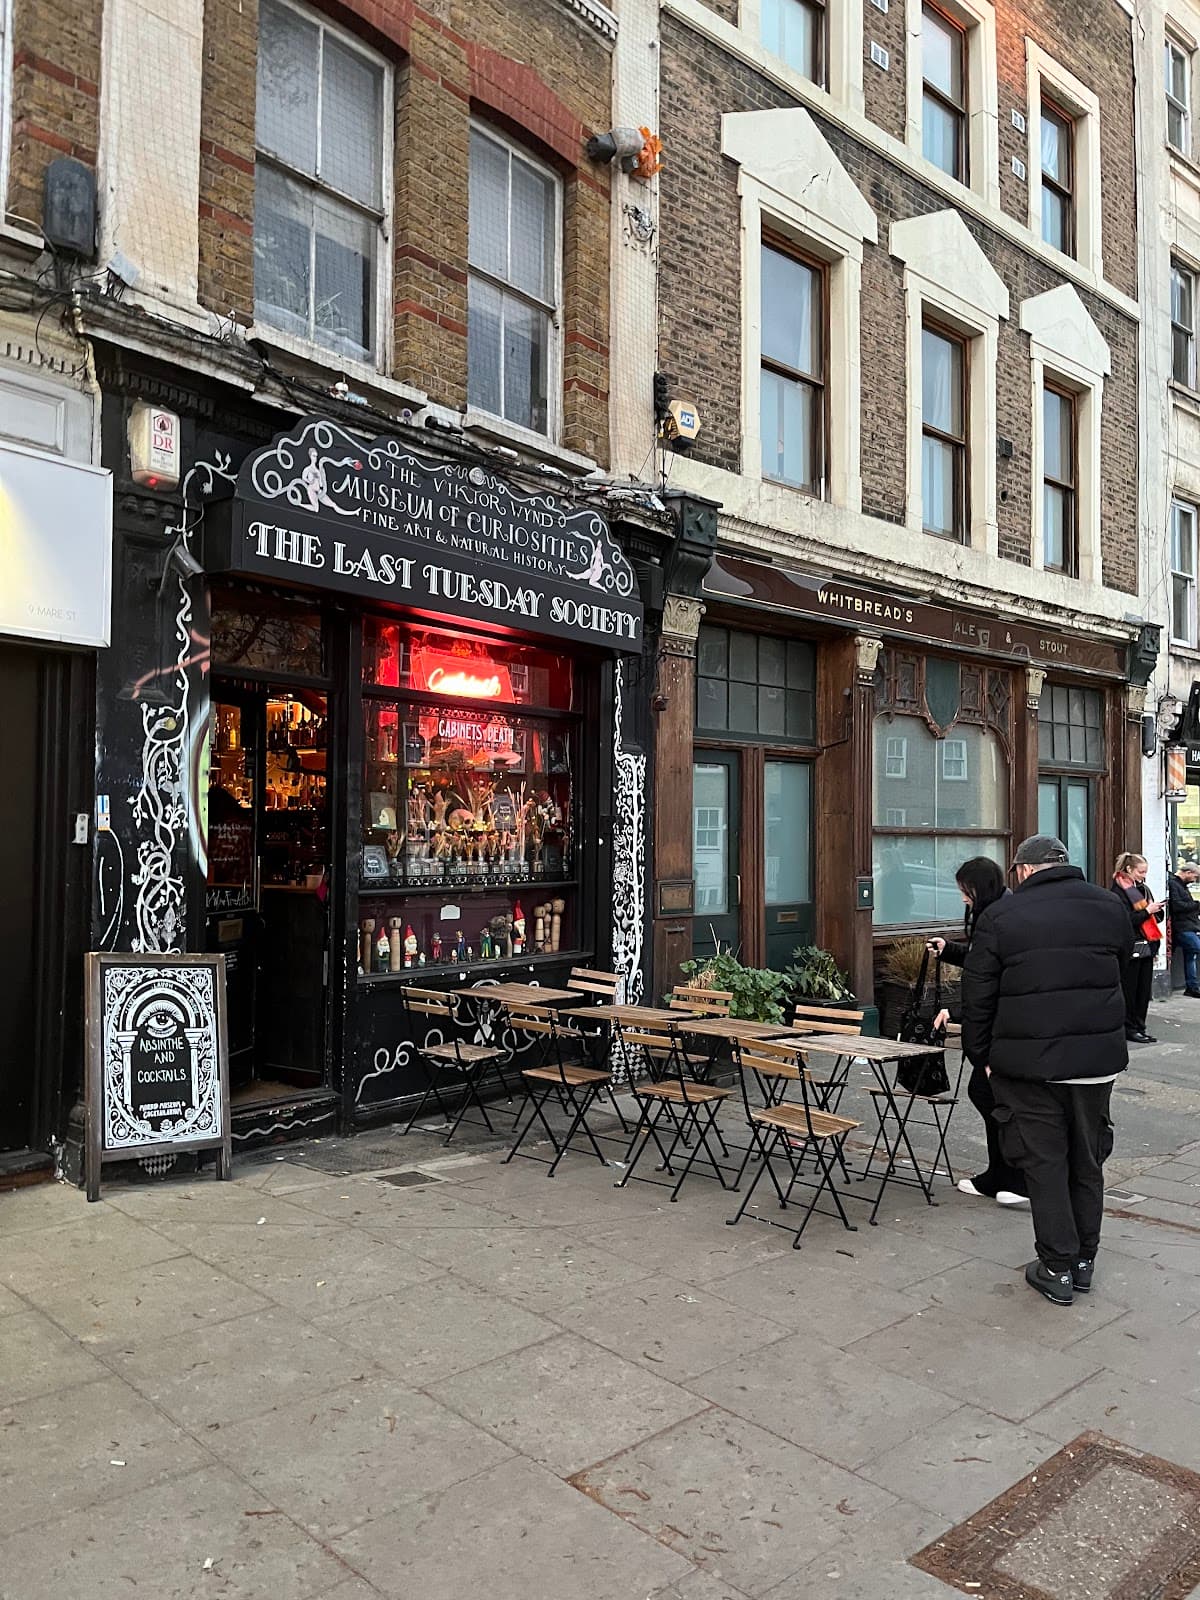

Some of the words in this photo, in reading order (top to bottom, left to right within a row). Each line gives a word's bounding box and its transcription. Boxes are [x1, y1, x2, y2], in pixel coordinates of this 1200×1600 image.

[153, 434, 174, 450] DR
[385, 460, 422, 488] THE
[433, 478, 507, 515] VIKTOR
[510, 502, 554, 528] WYND
[332, 473, 433, 521] MUSEUM
[438, 505, 461, 528] OF
[467, 511, 589, 566] CURIOSITIES
[363, 509, 400, 531] FINE
[403, 522, 432, 540] ART
[435, 530, 448, 545] &
[451, 535, 509, 561] NATURAL
[513, 551, 566, 576] HISTORY
[248, 521, 326, 568] THE
[332, 541, 417, 590] LAST
[422, 563, 545, 618] TUESDAY
[549, 596, 641, 640] SOCIETY
[37, 606, 63, 618] MARE
[817, 589, 913, 623] WHITBREAD'S
[953, 621, 976, 637] ALE
[1005, 631, 1012, 644] &
[1039, 639, 1068, 656] STOUT
[438, 719, 483, 741] CABINETS
[487, 725, 514, 745] DEATH
[139, 1036, 185, 1054] ABSINTHE
[154, 1051, 176, 1065] AND
[137, 1068, 187, 1083] COCKTAILS
